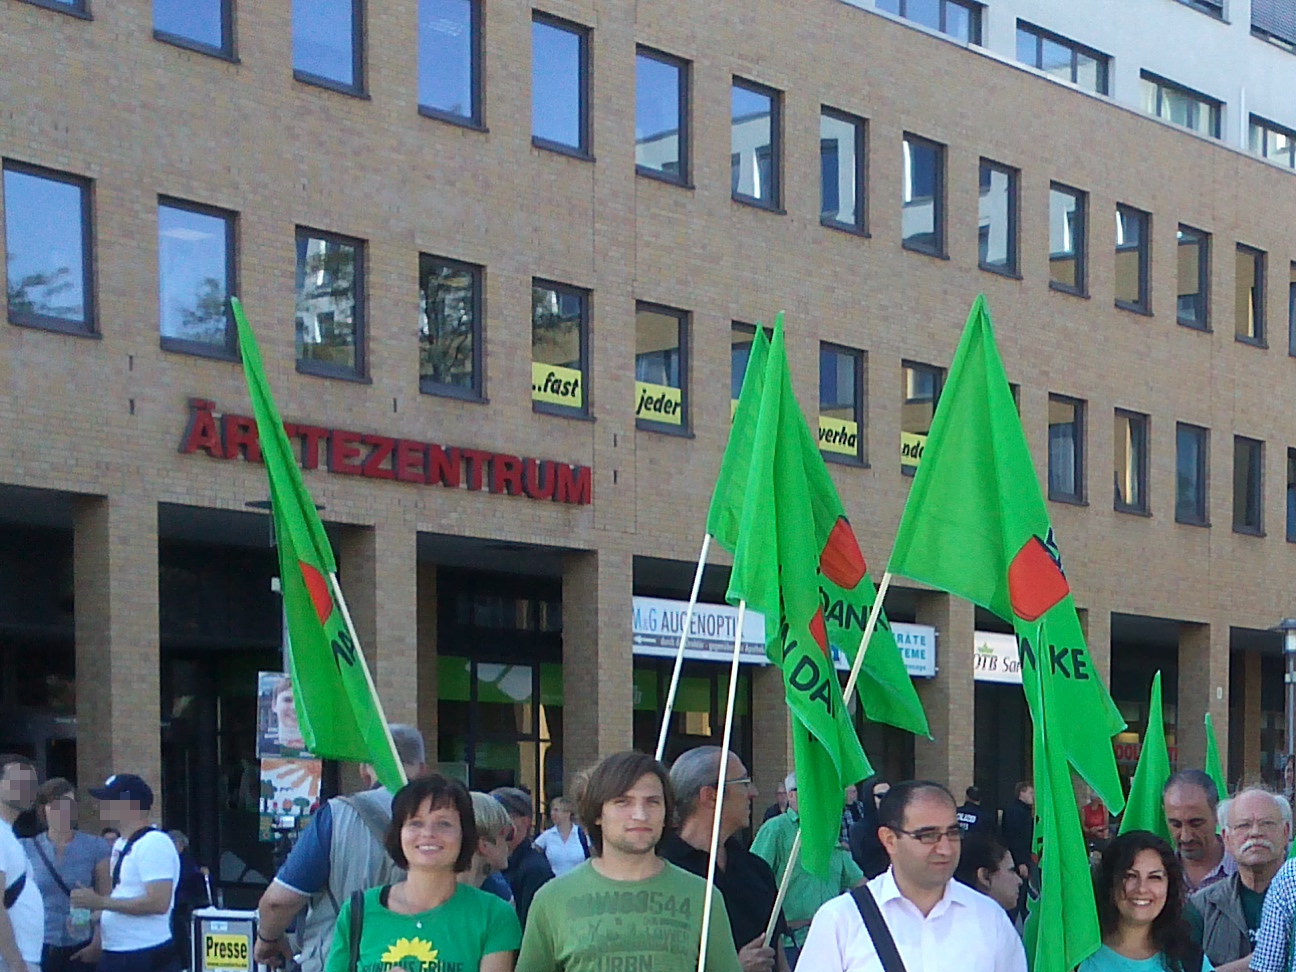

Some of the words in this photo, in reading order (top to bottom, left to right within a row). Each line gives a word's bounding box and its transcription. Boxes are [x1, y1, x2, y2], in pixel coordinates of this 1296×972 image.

[636, 388, 681, 415] jeder
[819, 425, 856, 448] verha
[182, 398, 592, 505] ÄRTEZENTRUM
[661, 610, 745, 638] AUGENOPTI
[892, 631, 926, 646] RÄTE
[206, 936, 248, 959] Presse
